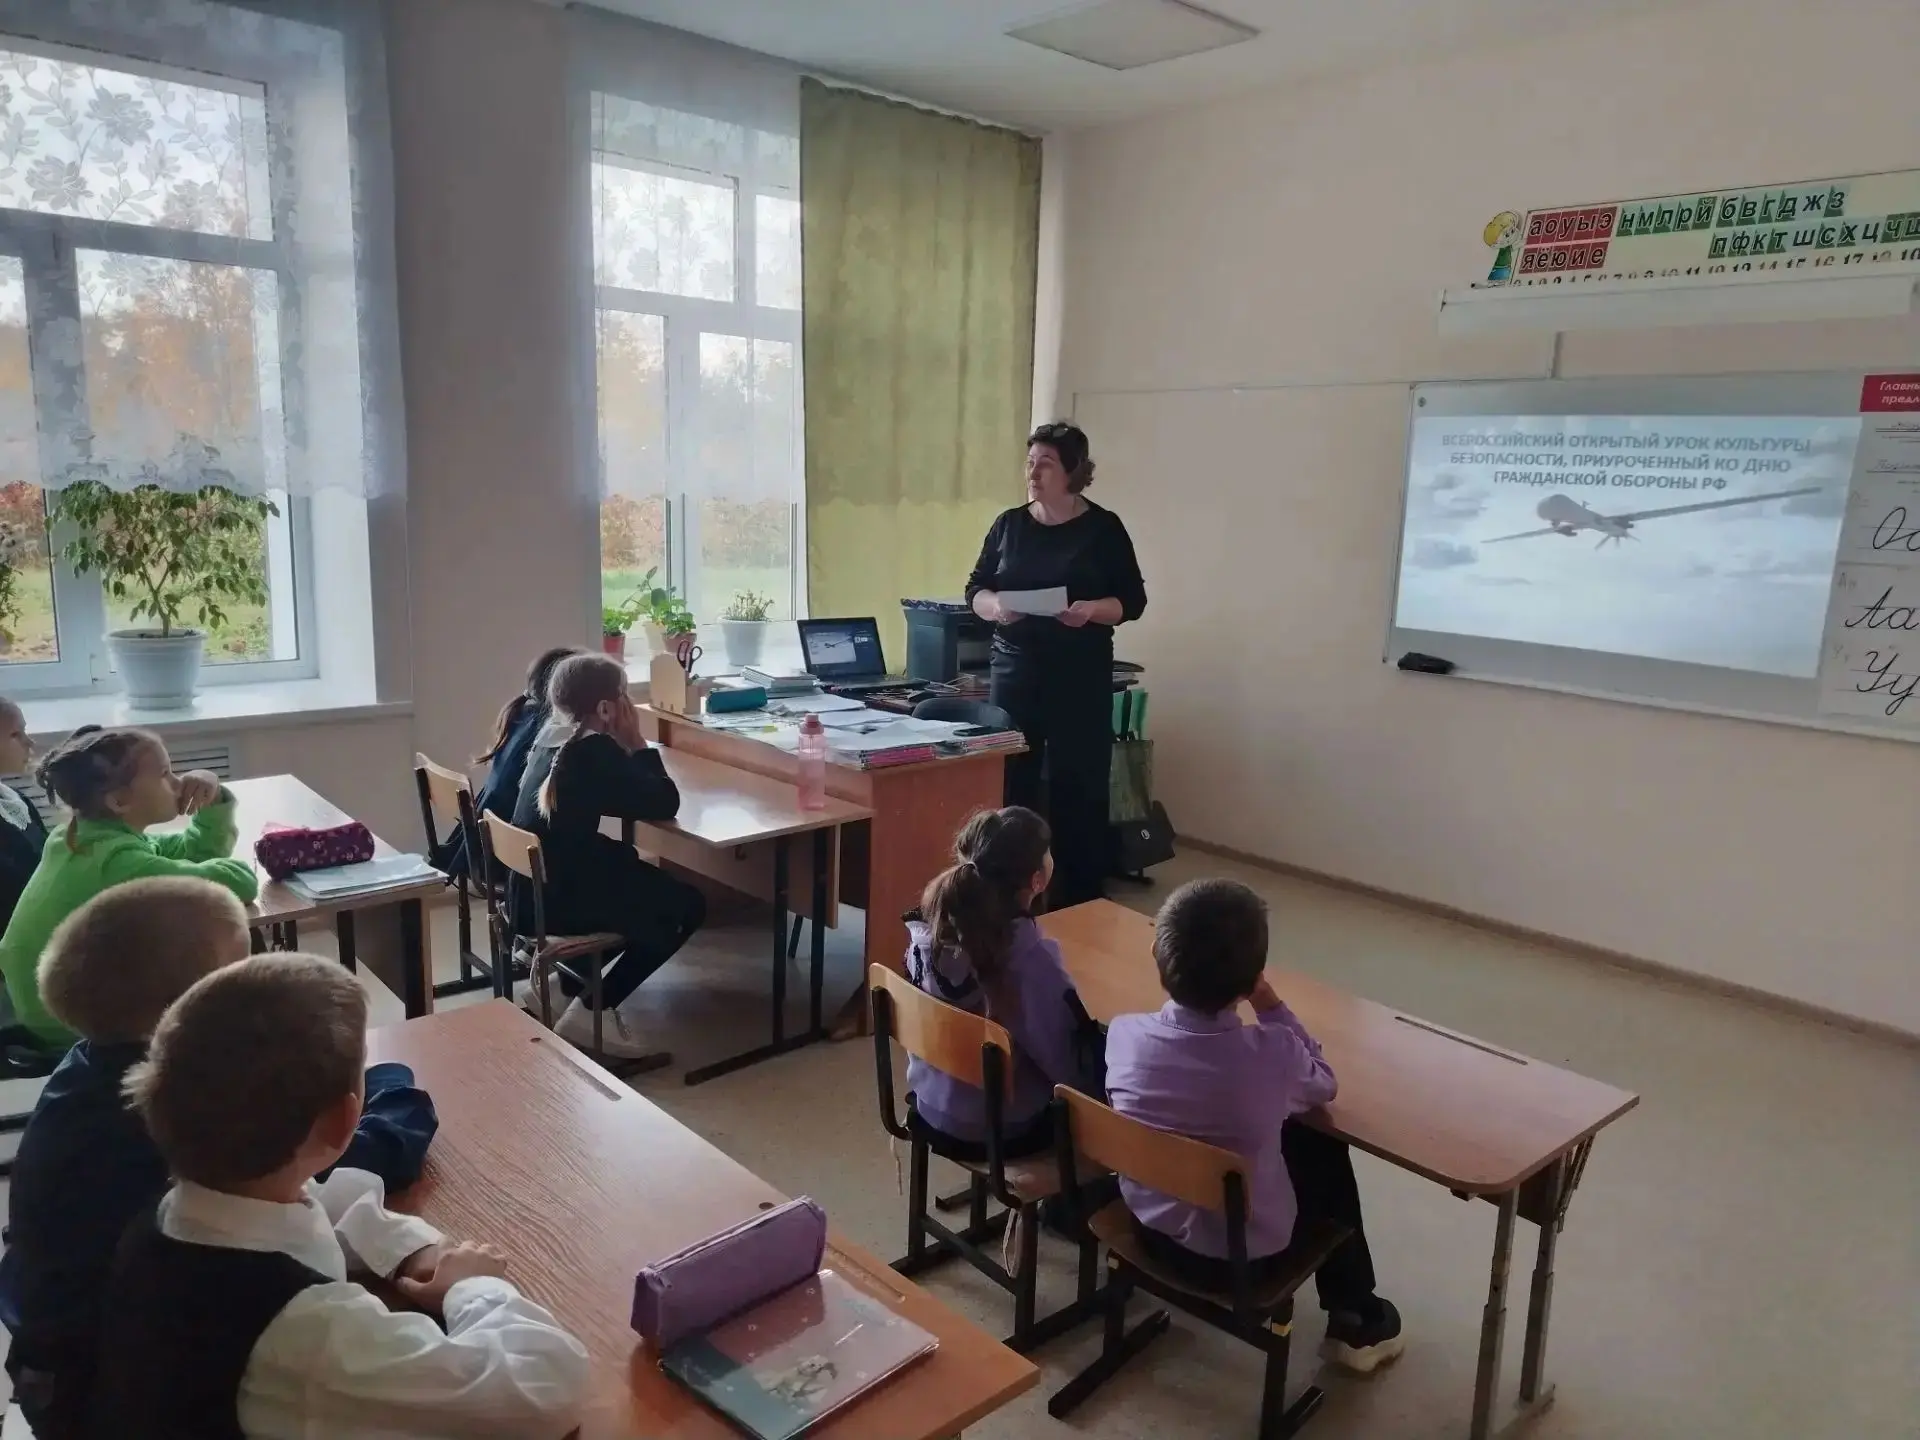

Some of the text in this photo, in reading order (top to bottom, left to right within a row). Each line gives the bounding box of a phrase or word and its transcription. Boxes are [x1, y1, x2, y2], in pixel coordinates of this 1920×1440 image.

[1442, 432, 1811, 452] ВСЕРОССИЙСКИЙ ОТКРЫТЫЙ УРОК КУЛЬТУРЫ
[1451, 452, 1792, 475] БЕЗОПАСНОСТИ, ПРИУРОЧЕННЫЙ КО ДНЮ
[1494, 470, 1727, 490] ГРАЖДАНСКОЙ ОБОРОНЫ РФ
